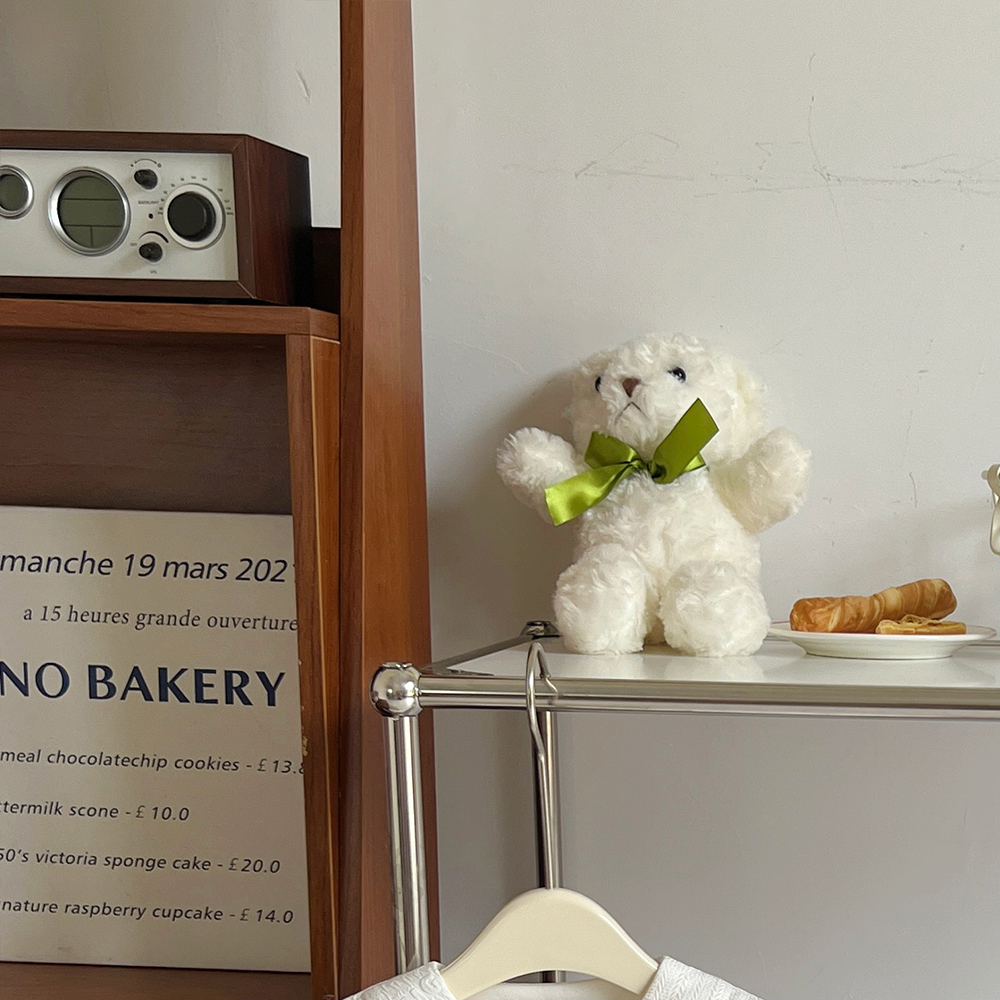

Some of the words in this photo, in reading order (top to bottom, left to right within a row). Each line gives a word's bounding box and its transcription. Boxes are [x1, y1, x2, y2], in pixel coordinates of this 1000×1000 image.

[0, 550, 114, 576] manche
[125, 554, 155, 577] 19
[163, 561, 229, 580] mars
[235, 558, 296, 583] 202
[23, 609, 32, 620] a
[40, 606, 61, 621] 15
[67, 605, 129, 624] heures
[135, 609, 200, 630] grande
[207, 613, 297, 631] ouverture
[0, 661, 70, 698] NO
[88, 665, 286, 707] BAKERY
[0, 749, 41, 763] meal
[47, 750, 168, 770] chocolatechip
[175, 757, 239, 771] cookies
[69, 806, 119, 818] scone
[36, 850, 97, 865] victoria
[103, 856, 166, 871] sponge
[173, 856, 211, 870] cake
[0, 900, 58, 913] nature
[65, 902, 147, 920] raspberry
[152, 906, 223, 922] cupcake
